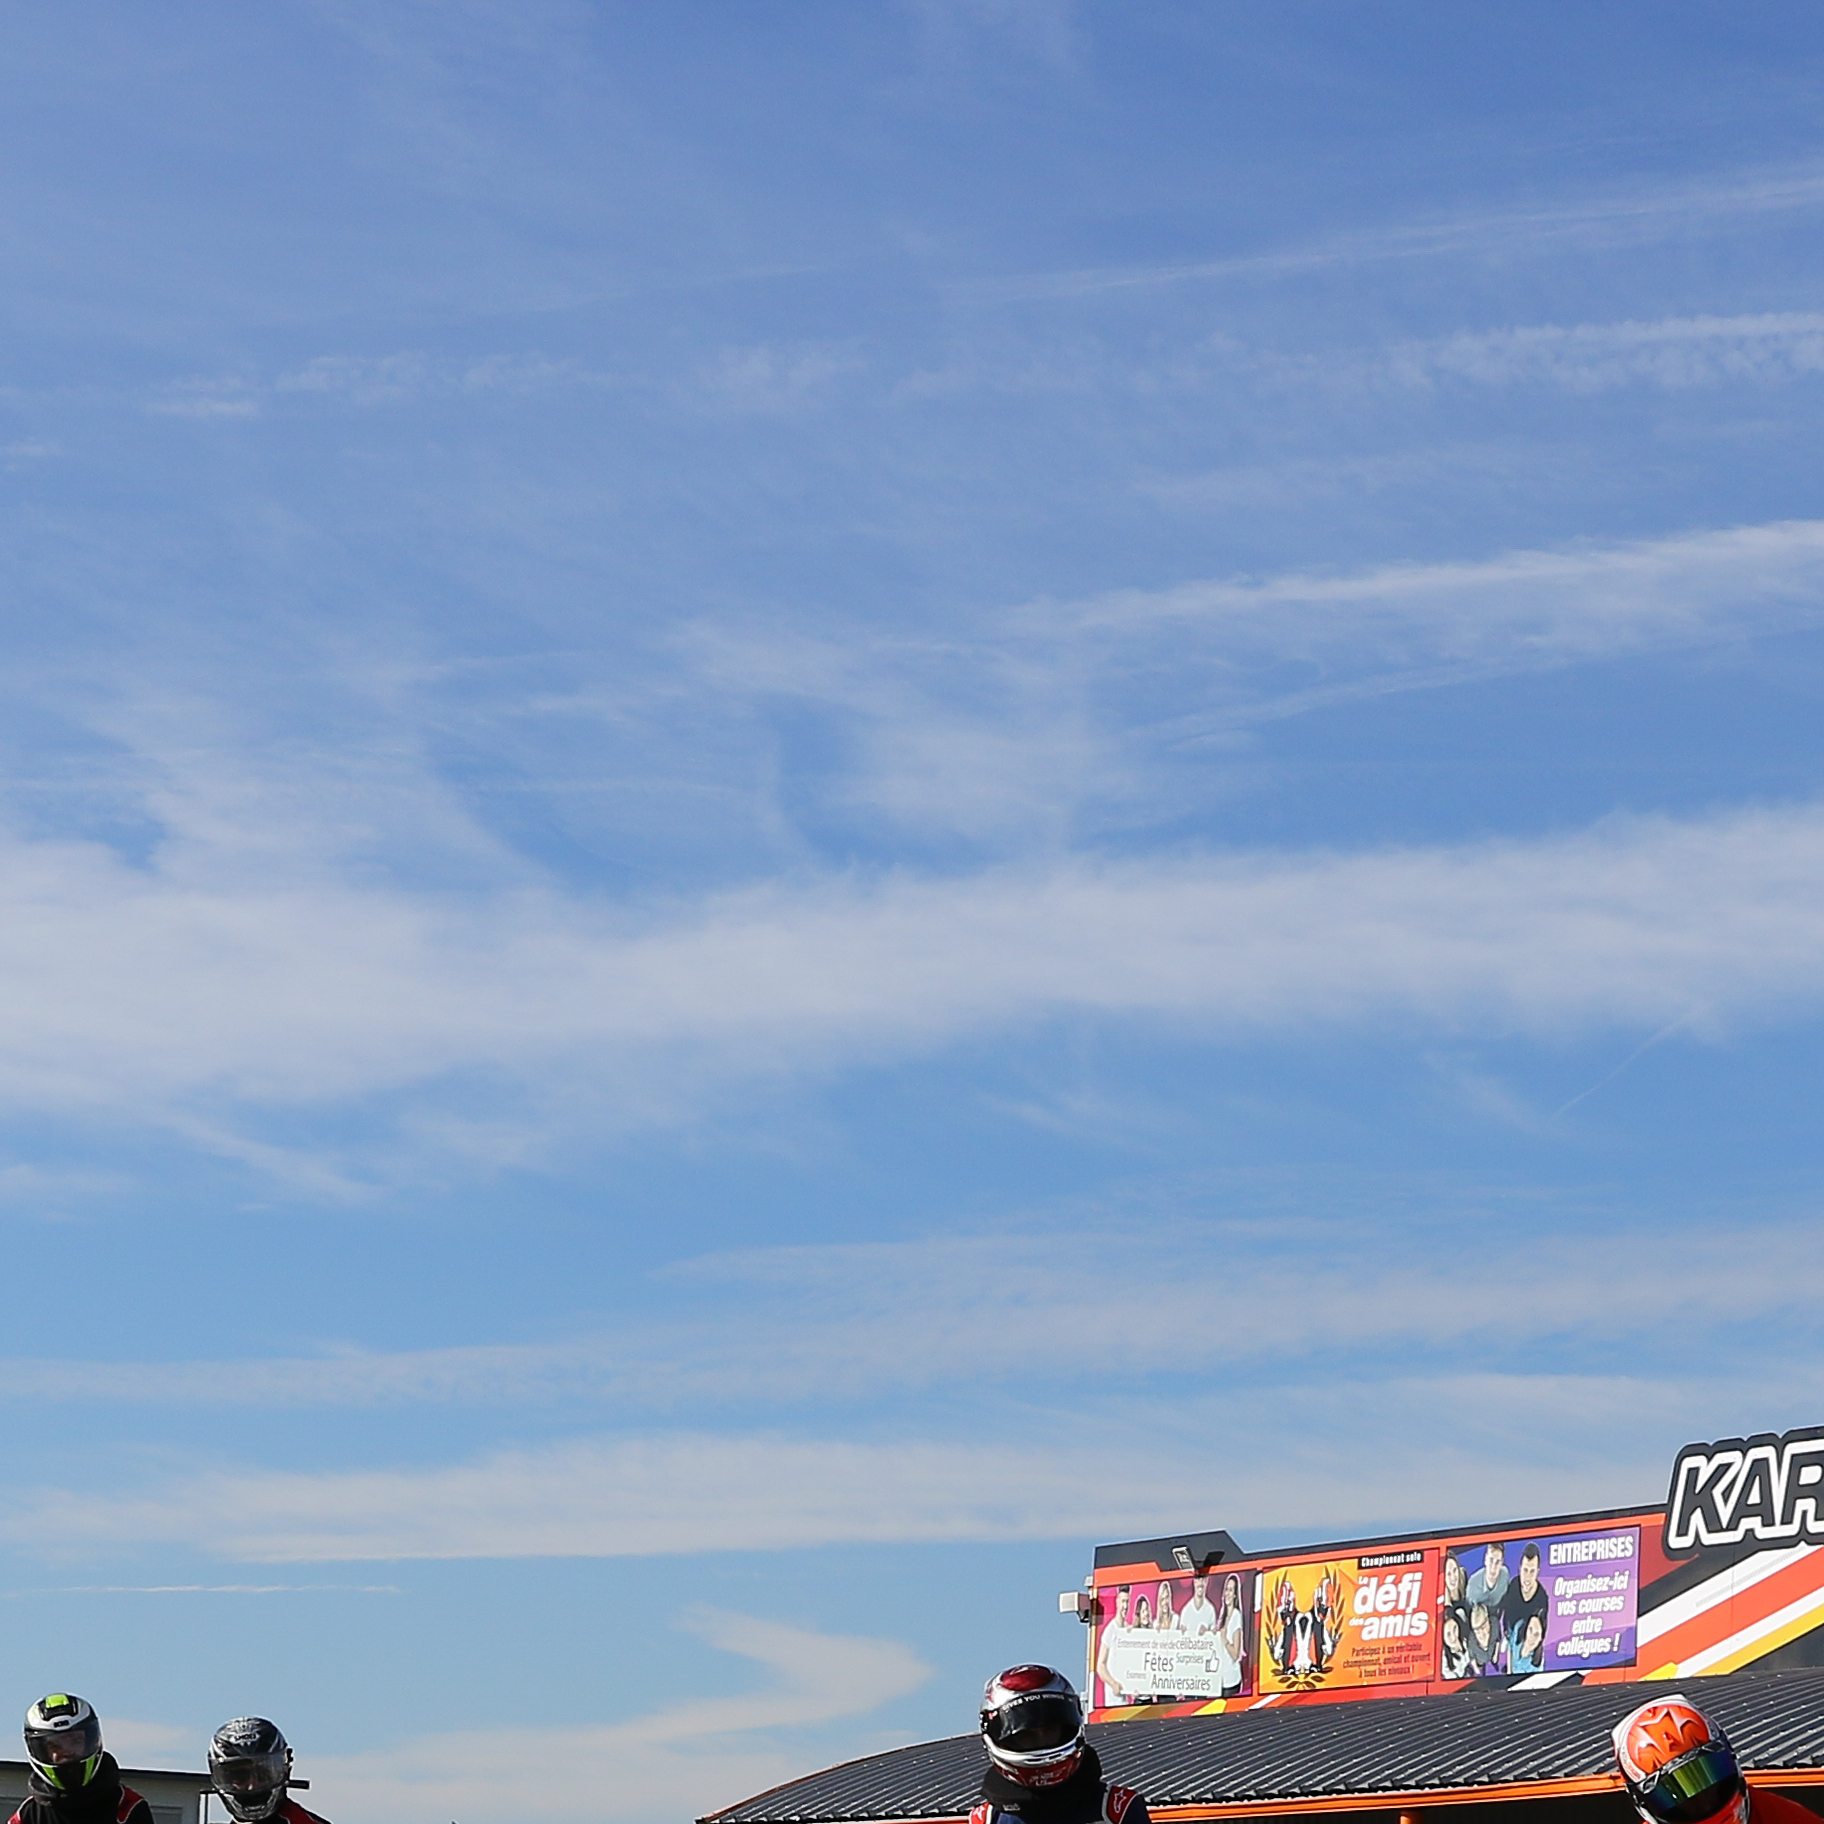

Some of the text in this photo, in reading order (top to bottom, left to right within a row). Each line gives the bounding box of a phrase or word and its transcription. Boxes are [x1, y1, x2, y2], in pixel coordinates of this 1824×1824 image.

[1549, 1535, 1634, 1565] ENTREPRISES
[1360, 1553, 1405, 1568] Championnat
[1353, 1571, 1424, 1615] défi
[1554, 1569, 1630, 1599] Organisez-ici
[1556, 1595, 1625, 1616] vos courses
[1360, 1607, 1429, 1641] amis
[1571, 1615, 1603, 1635] entre
[1175, 1637, 1214, 1651] célibataire
[1556, 1632, 1621, 1658] collègues !
[1144, 1652, 1205, 1672] Fêtes Surprises
[1150, 1674, 1211, 1692] Anniversaires
[1023, 1692, 1041, 1703] YOU
